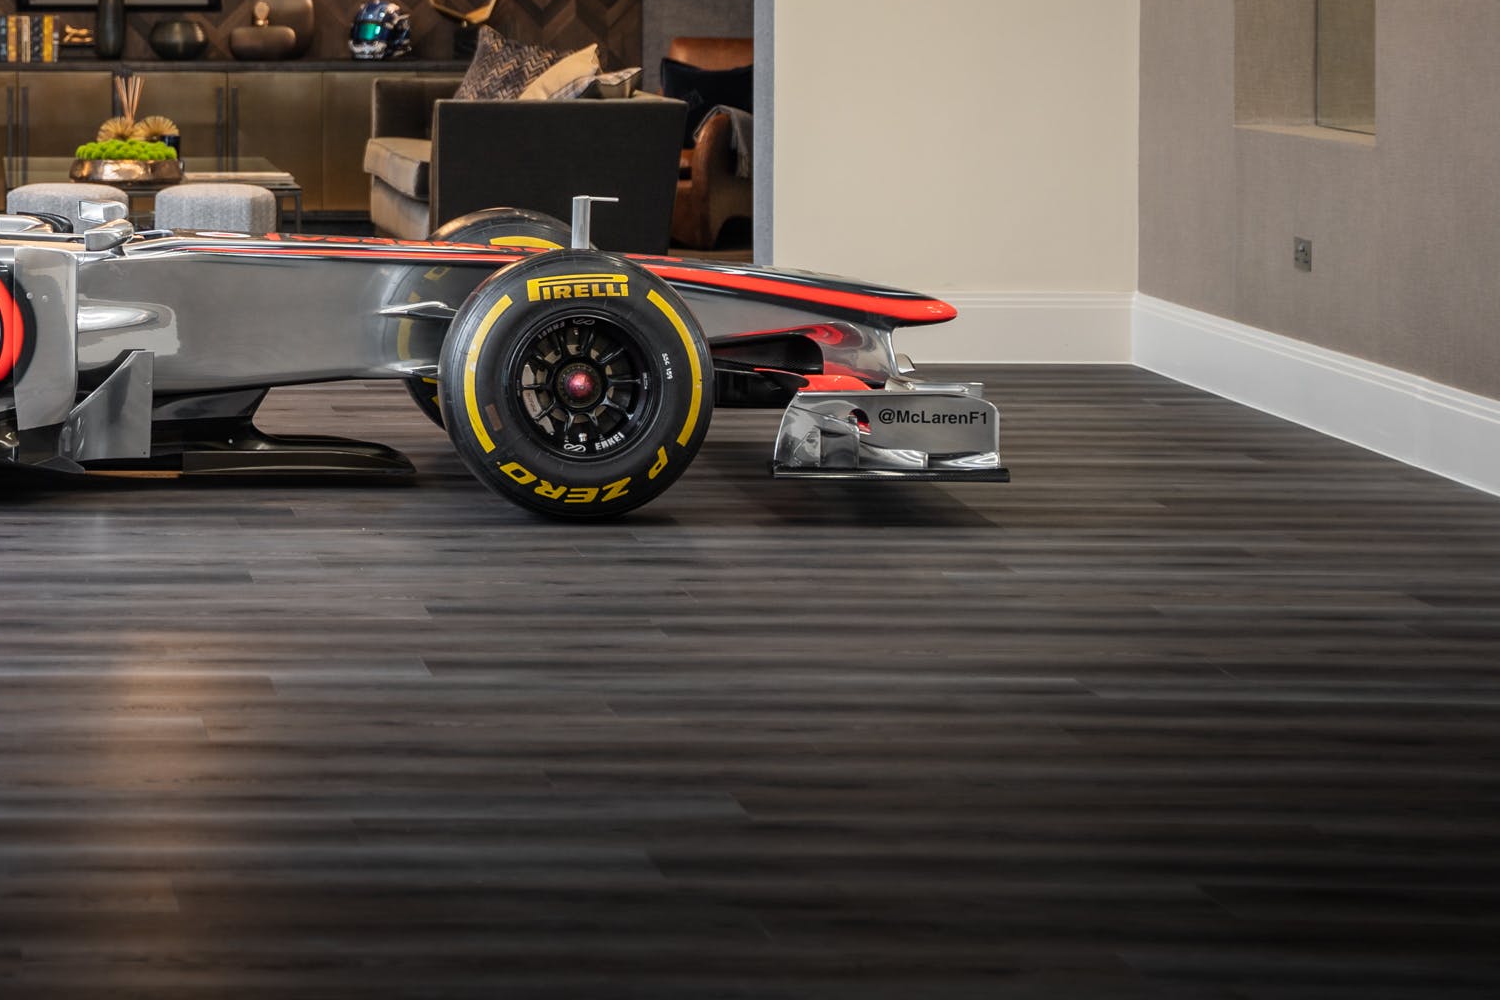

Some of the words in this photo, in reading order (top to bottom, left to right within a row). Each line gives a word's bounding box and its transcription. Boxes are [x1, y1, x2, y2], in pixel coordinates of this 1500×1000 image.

[527, 273, 629, 301] PIRELLI
[878, 408, 988, 425] @McLarenF1
[649, 446, 668, 481] P
[499, 461, 632, 504] ZERO
